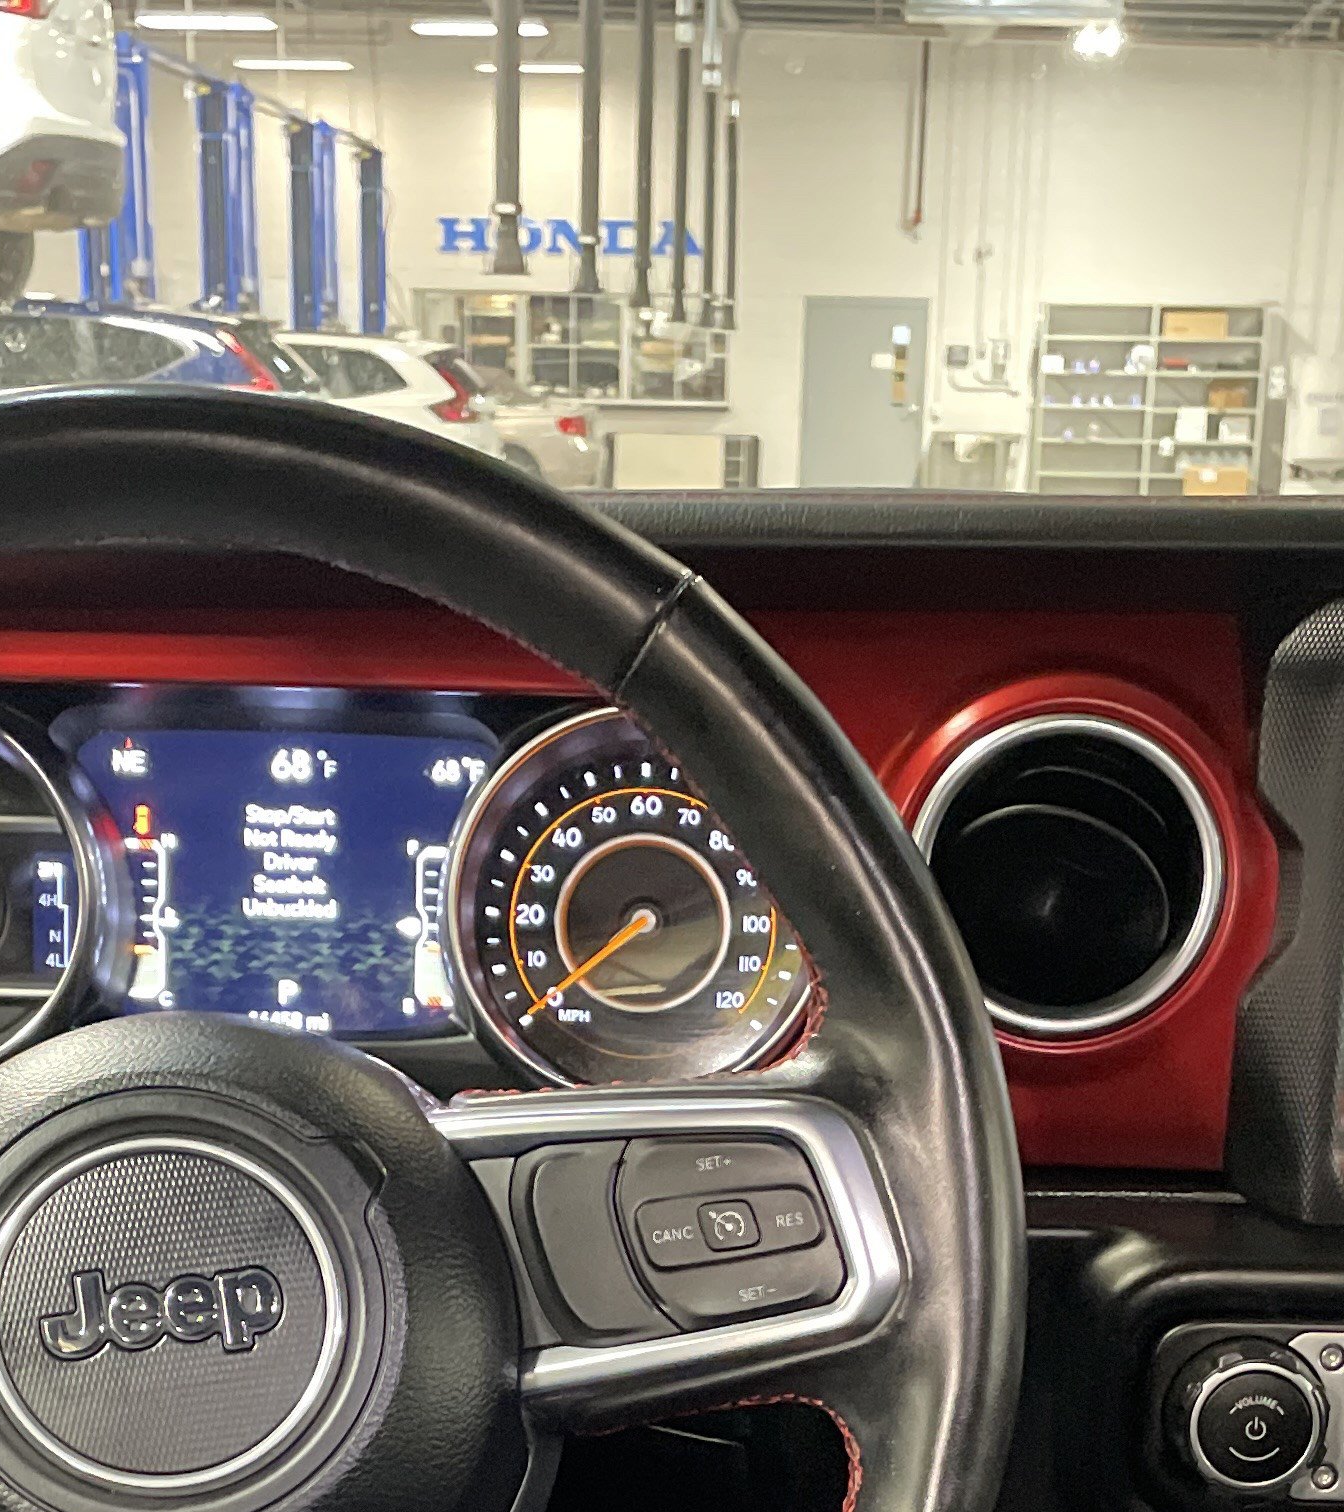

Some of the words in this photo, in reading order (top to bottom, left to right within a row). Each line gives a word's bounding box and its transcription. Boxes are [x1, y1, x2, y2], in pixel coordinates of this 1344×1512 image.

[111, 749, 149, 775] NE
[591, 806, 617, 824] 50
[630, 795, 662, 816] 60
[244, 803, 337, 829] Stop/Start
[677, 808, 702, 826] 70
[243, 829, 278, 848] Not
[280, 829, 338, 854] Ready
[552, 827, 582, 849] 40
[263, 853, 319, 872] Driver
[530, 865, 555, 883] 30
[242, 897, 339, 919] Unbuckled
[516, 904, 545, 925] 20
[742, 915, 771, 934] 100
[49, 929, 62, 943] N
[527, 951, 547, 968] 10
[739, 955, 761, 972] 110
[277, 979, 301, 1007] P
[716, 991, 744, 1010] 120
[558, 1009, 591, 1023] MPH
[775, 1212, 805, 1229] RES
[652, 1225, 695, 1244] CANC
[40, 1265, 286, 1361] Jeep
